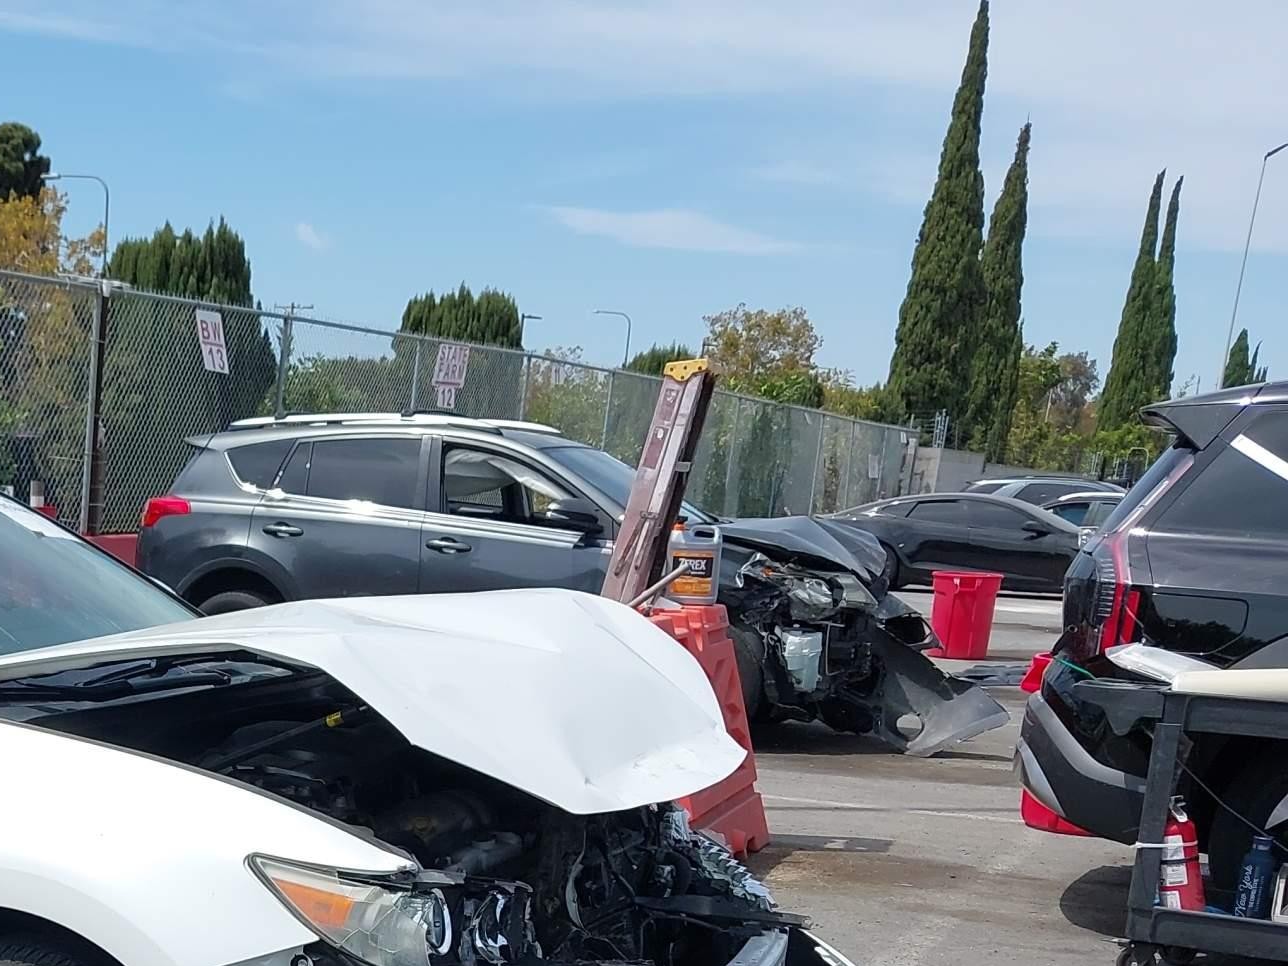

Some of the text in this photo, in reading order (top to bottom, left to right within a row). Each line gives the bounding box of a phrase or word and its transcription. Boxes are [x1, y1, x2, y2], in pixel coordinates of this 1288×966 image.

[207, 347, 226, 371] 13
[439, 345, 470, 365] STATE
[440, 388, 454, 407] 12
[1239, 864, 1253, 891] York
